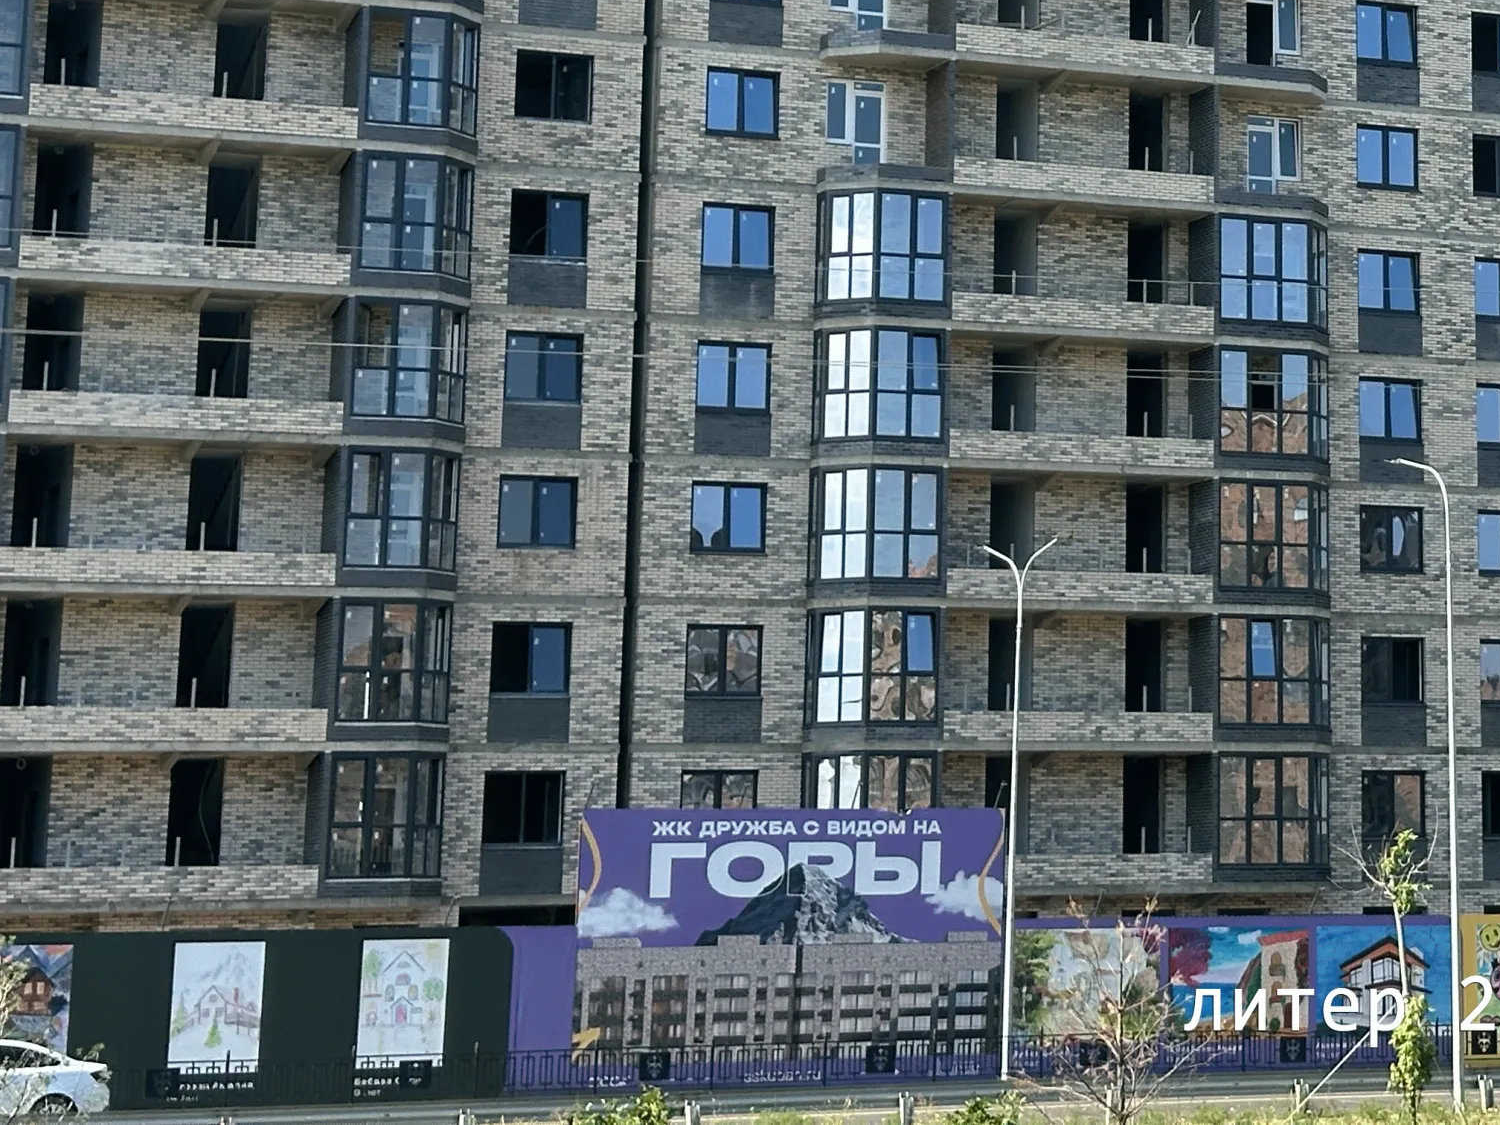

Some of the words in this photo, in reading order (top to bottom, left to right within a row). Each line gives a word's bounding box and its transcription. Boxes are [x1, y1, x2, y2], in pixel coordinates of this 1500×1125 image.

[652, 820, 692, 836] ЖК
[698, 820, 797, 838] ДРУЖБА
[803, 820, 820, 835] С
[827, 819, 906, 837] ВИДОМ
[913, 819, 942, 835] НА
[650, 840, 942, 899] ГОРЫ
